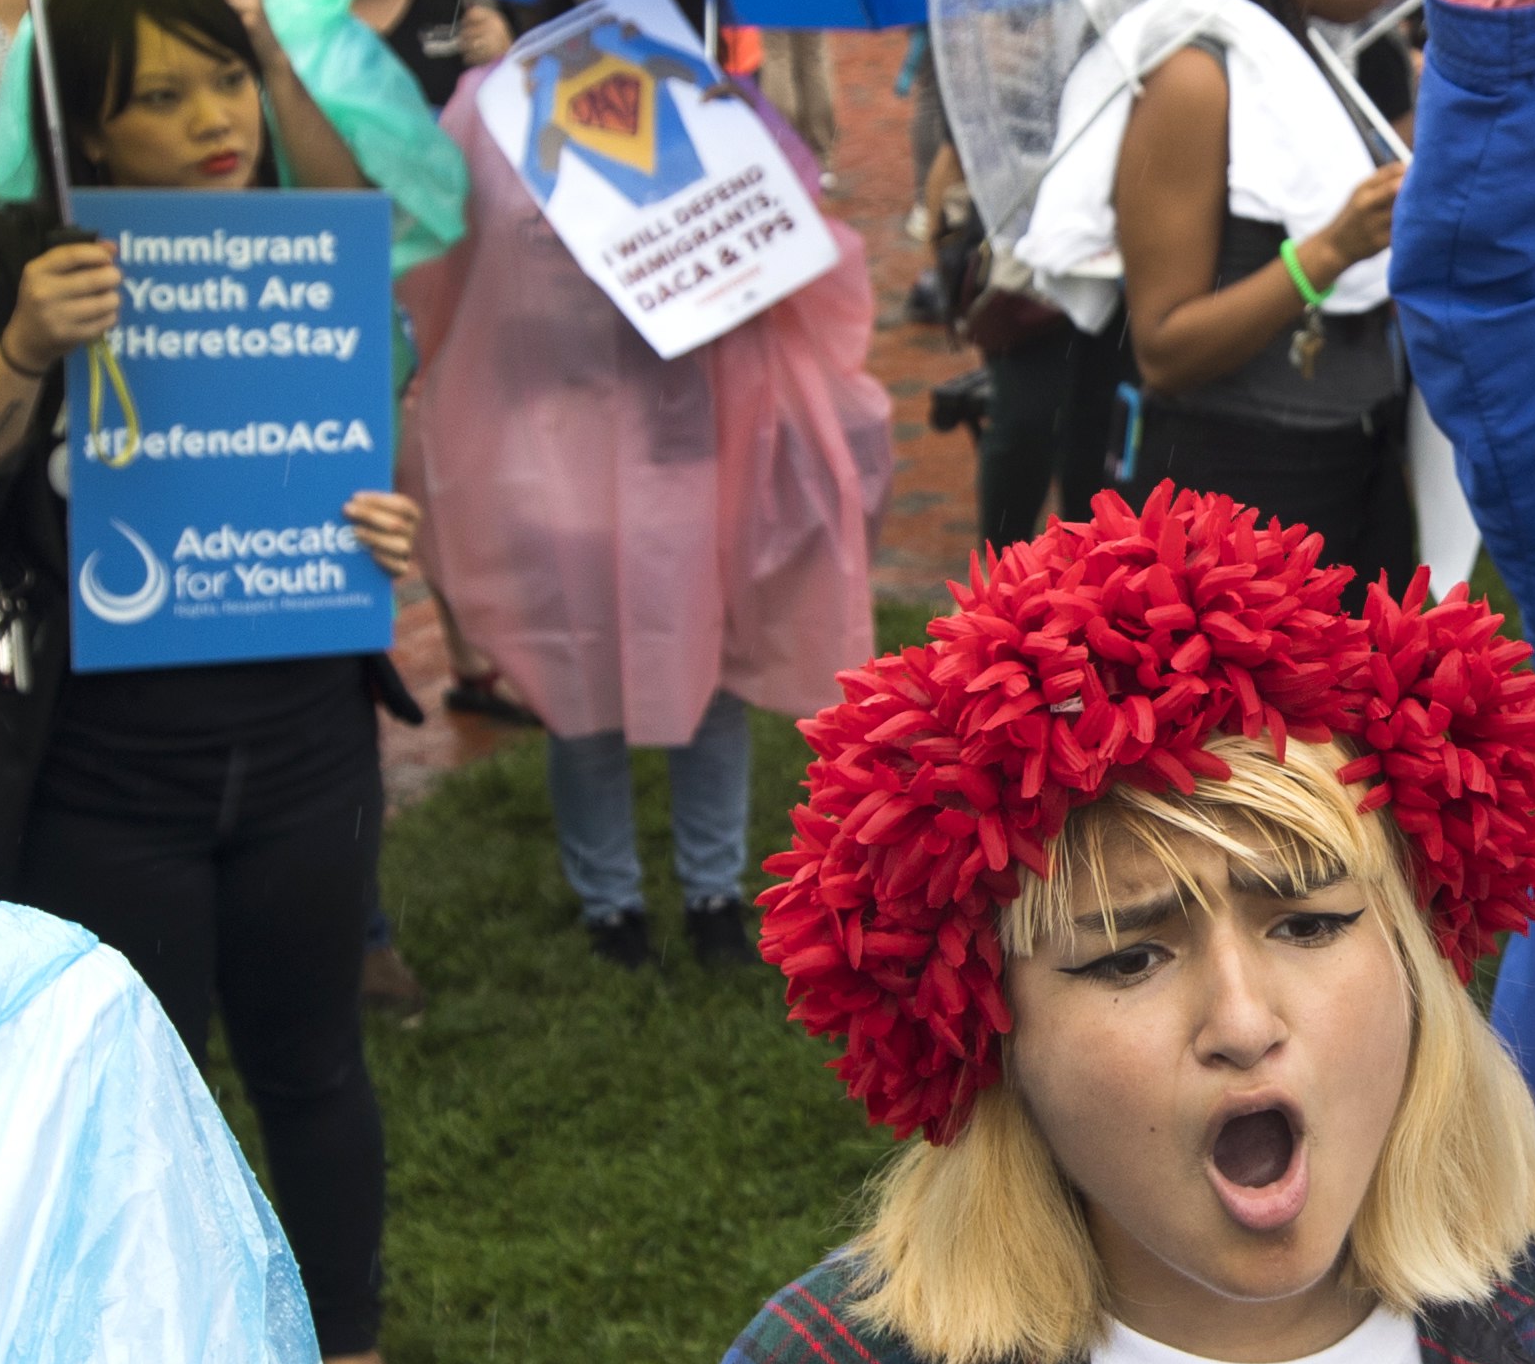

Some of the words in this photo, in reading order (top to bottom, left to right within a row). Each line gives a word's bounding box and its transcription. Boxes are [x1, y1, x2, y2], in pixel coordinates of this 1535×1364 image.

[614, 219, 672, 259] WILL
[674, 164, 764, 226] DEFEND
[119, 229, 336, 270] Immigrant
[618, 191, 781, 290] IMMIGRANTS,
[635, 261, 714, 312] DACA
[718, 244, 741, 267] &
[745, 209, 796, 252] TPS
[123, 275, 249, 312] Youth
[258, 275, 334, 311] Are
[104, 322, 360, 362] #HeretoStay
[84, 419, 373, 460] #DefendDACA
[174, 520, 359, 561] Advocate
[174, 562, 229, 600] for
[234, 558, 347, 597] Youth
